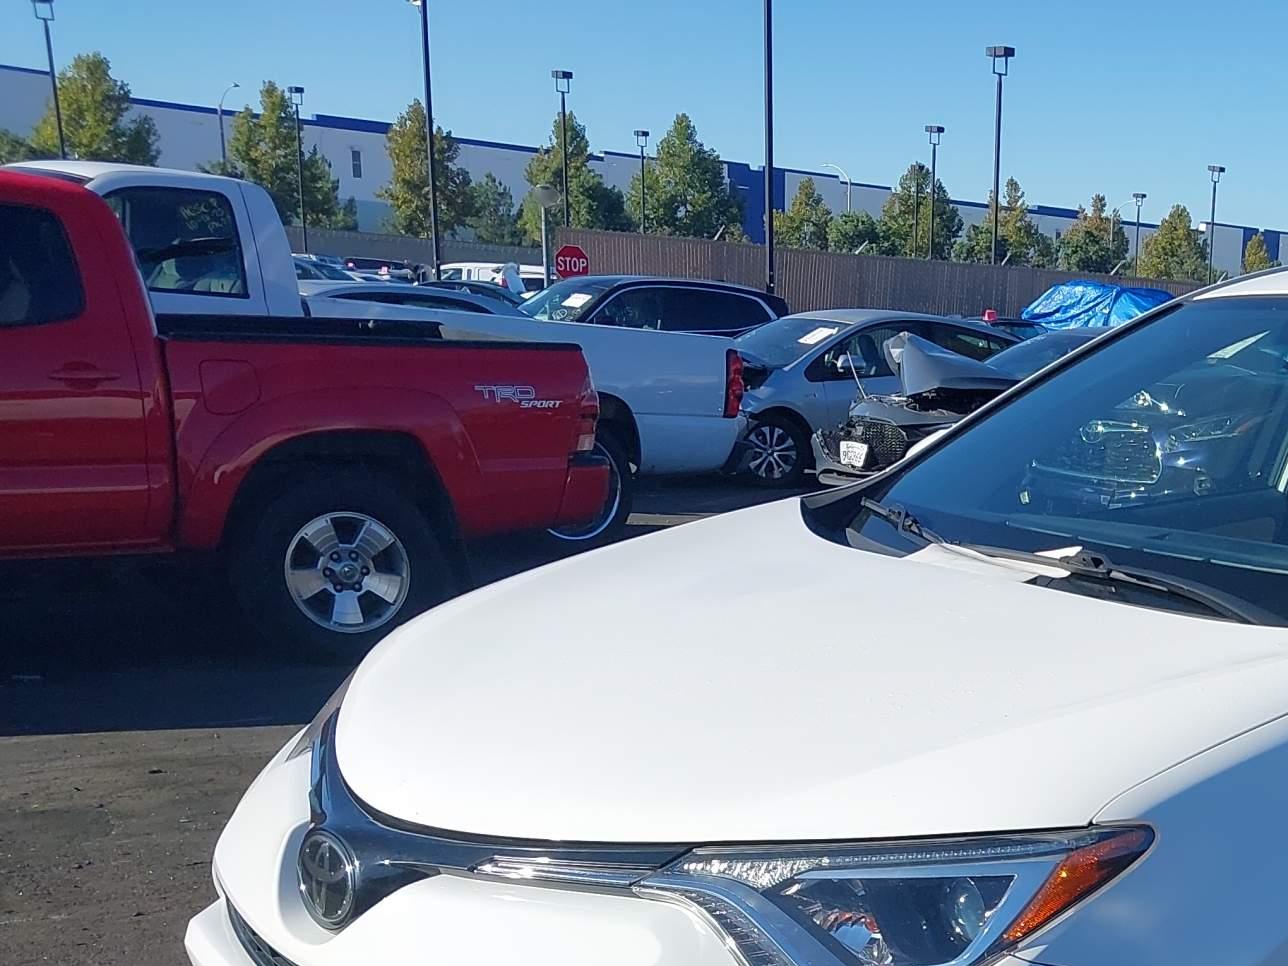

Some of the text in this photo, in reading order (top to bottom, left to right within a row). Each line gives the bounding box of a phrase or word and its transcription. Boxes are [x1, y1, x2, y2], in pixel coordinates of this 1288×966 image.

[557, 256, 587, 273] STOP
[474, 385, 536, 403] TRD
[520, 400, 564, 408] SPORT
